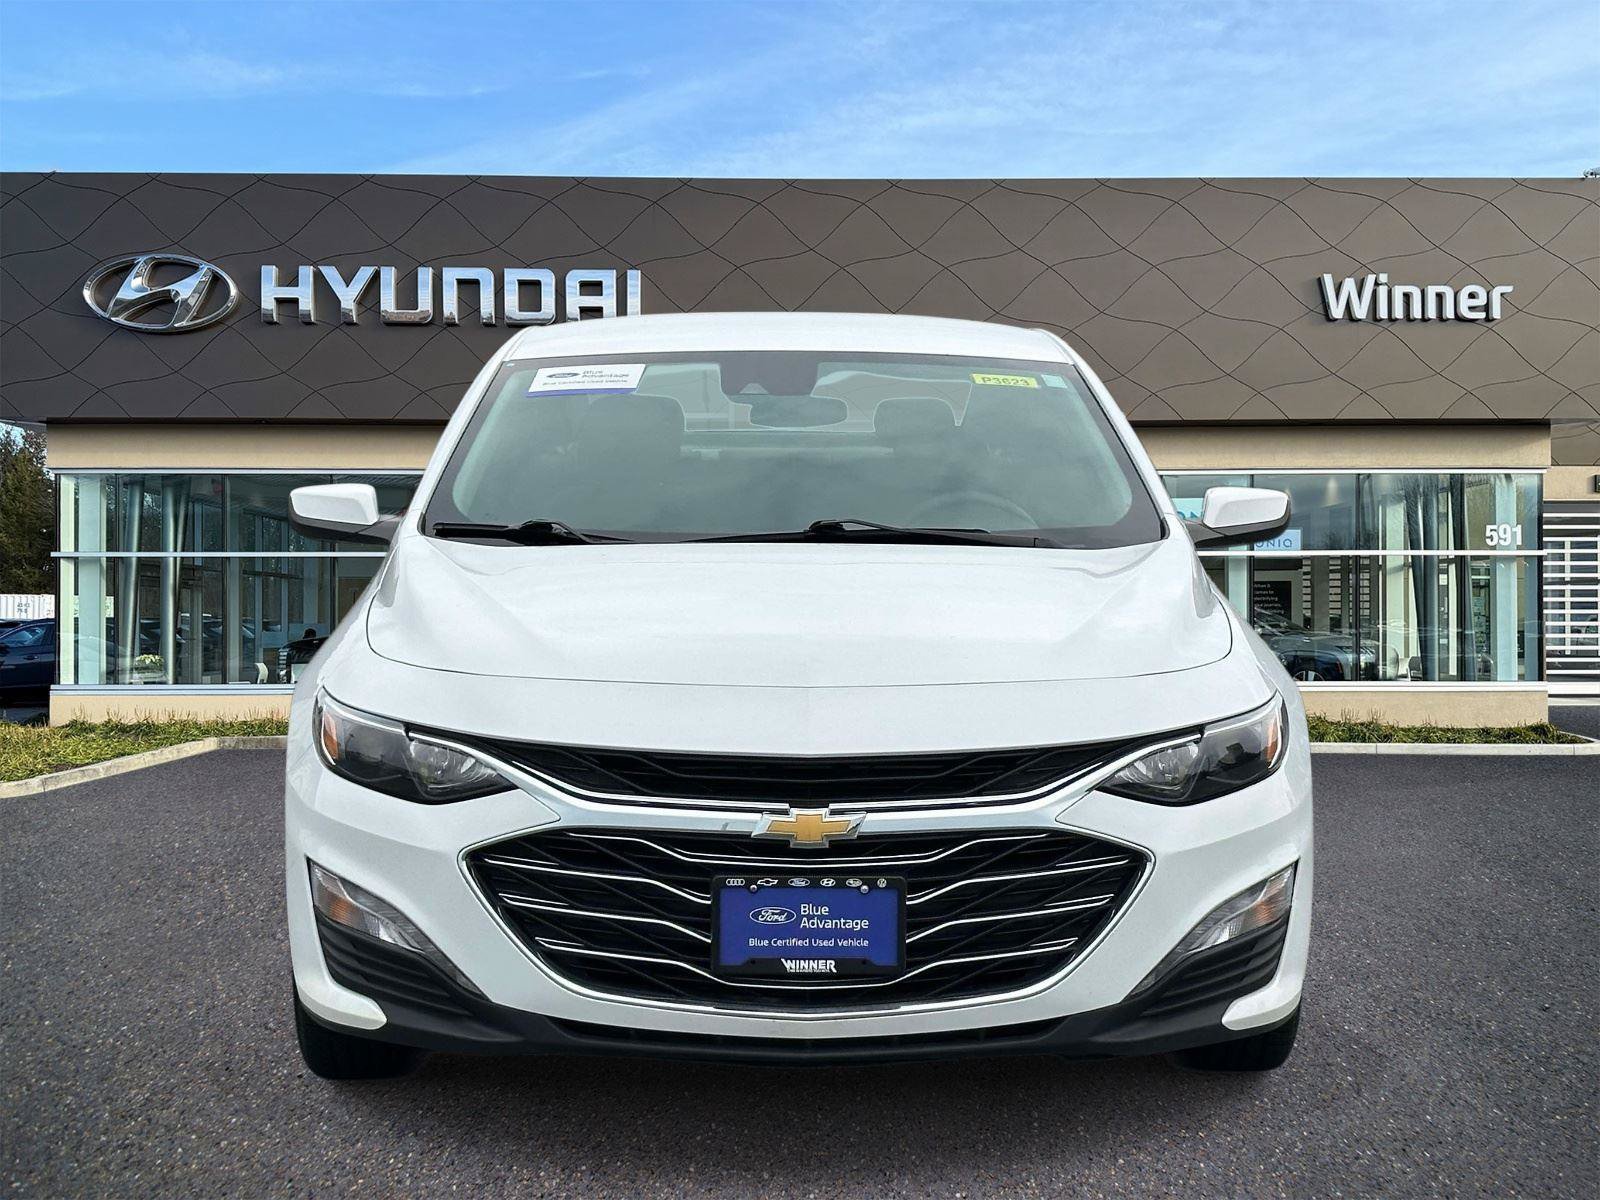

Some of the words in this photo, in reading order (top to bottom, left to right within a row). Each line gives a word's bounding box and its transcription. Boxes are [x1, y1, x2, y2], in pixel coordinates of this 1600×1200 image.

[261, 265, 642, 326] HYUNDAI
[1319, 272, 1515, 321] Winner
[1485, 524, 1522, 546] 591
[1255, 538, 1293, 547] ONIQ
[758, 909, 788, 922] Ford
[800, 904, 829, 915] Blue
[800, 917, 869, 931] Advantage
[749, 938, 769, 947] Blue
[771, 938, 809, 947] Certified
[811, 938, 834, 947] Used
[837, 938, 869, 947] Vehicle
[780, 958, 837, 973] WINNER
